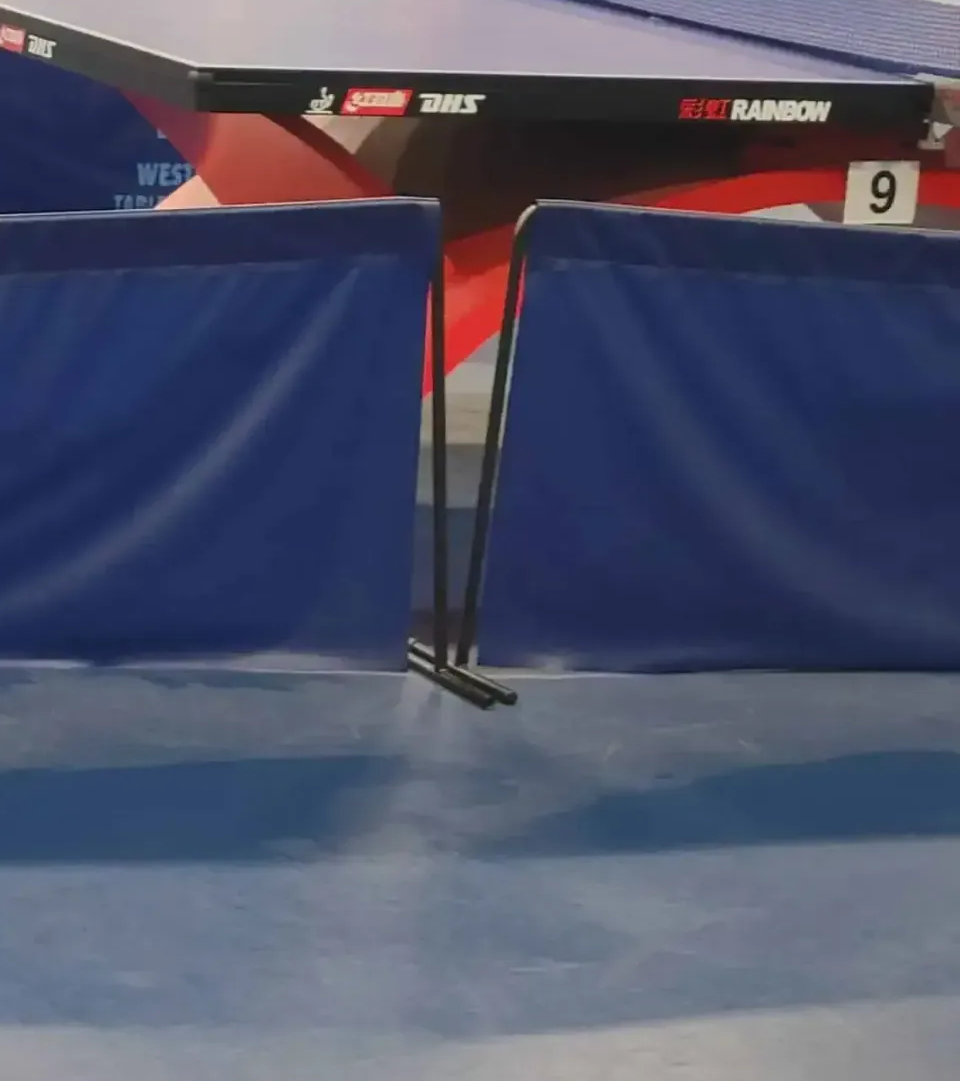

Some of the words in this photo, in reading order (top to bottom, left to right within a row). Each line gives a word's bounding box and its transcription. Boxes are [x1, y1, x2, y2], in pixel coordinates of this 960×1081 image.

[418, 92, 487, 114] DHS
[729, 98, 833, 123] RAINBOW
[869, 169, 898, 215] 9
